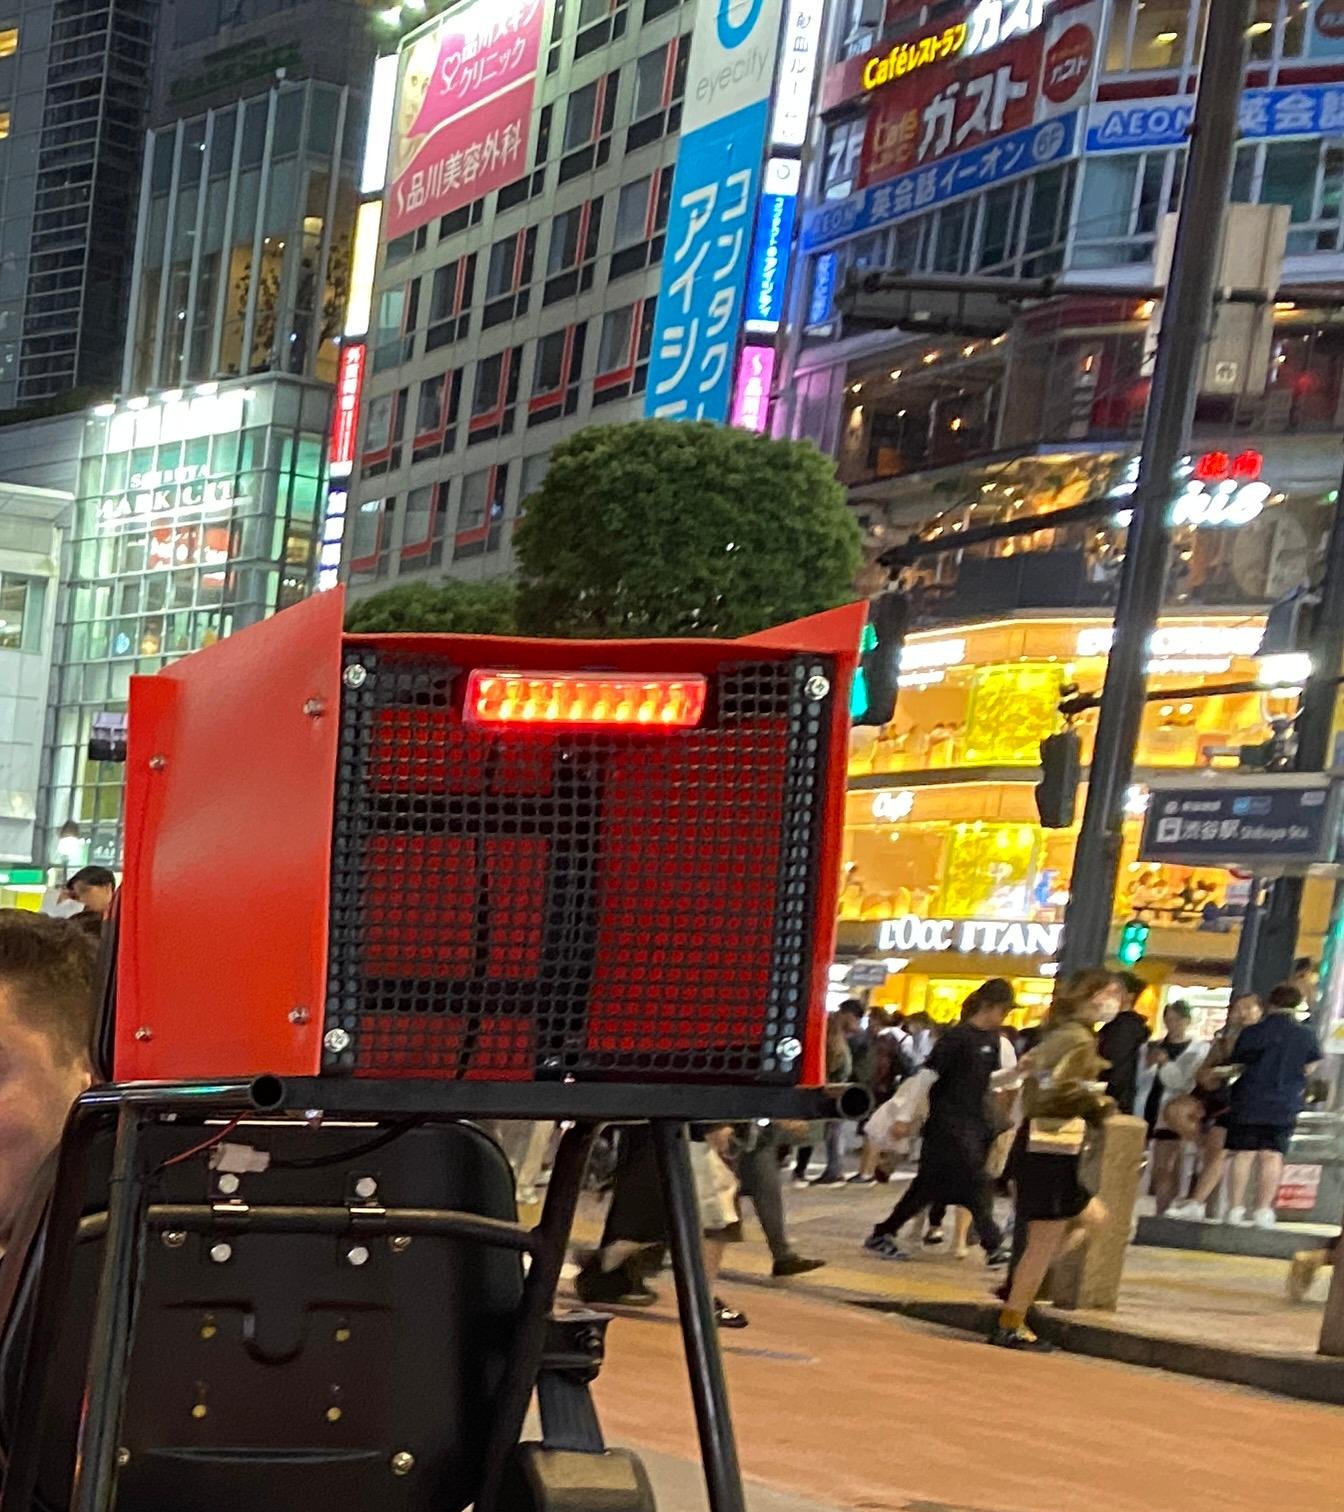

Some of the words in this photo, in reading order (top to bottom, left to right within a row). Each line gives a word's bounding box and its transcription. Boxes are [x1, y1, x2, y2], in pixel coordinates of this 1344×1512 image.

[458, 36, 526, 98] クリニック
[918, 63, 1027, 162] ガスト
[1104, 103, 1193, 138] AEON
[406, 119, 522, 212] 品川美容外科
[869, 143, 1026, 222] 英会話イーオン
